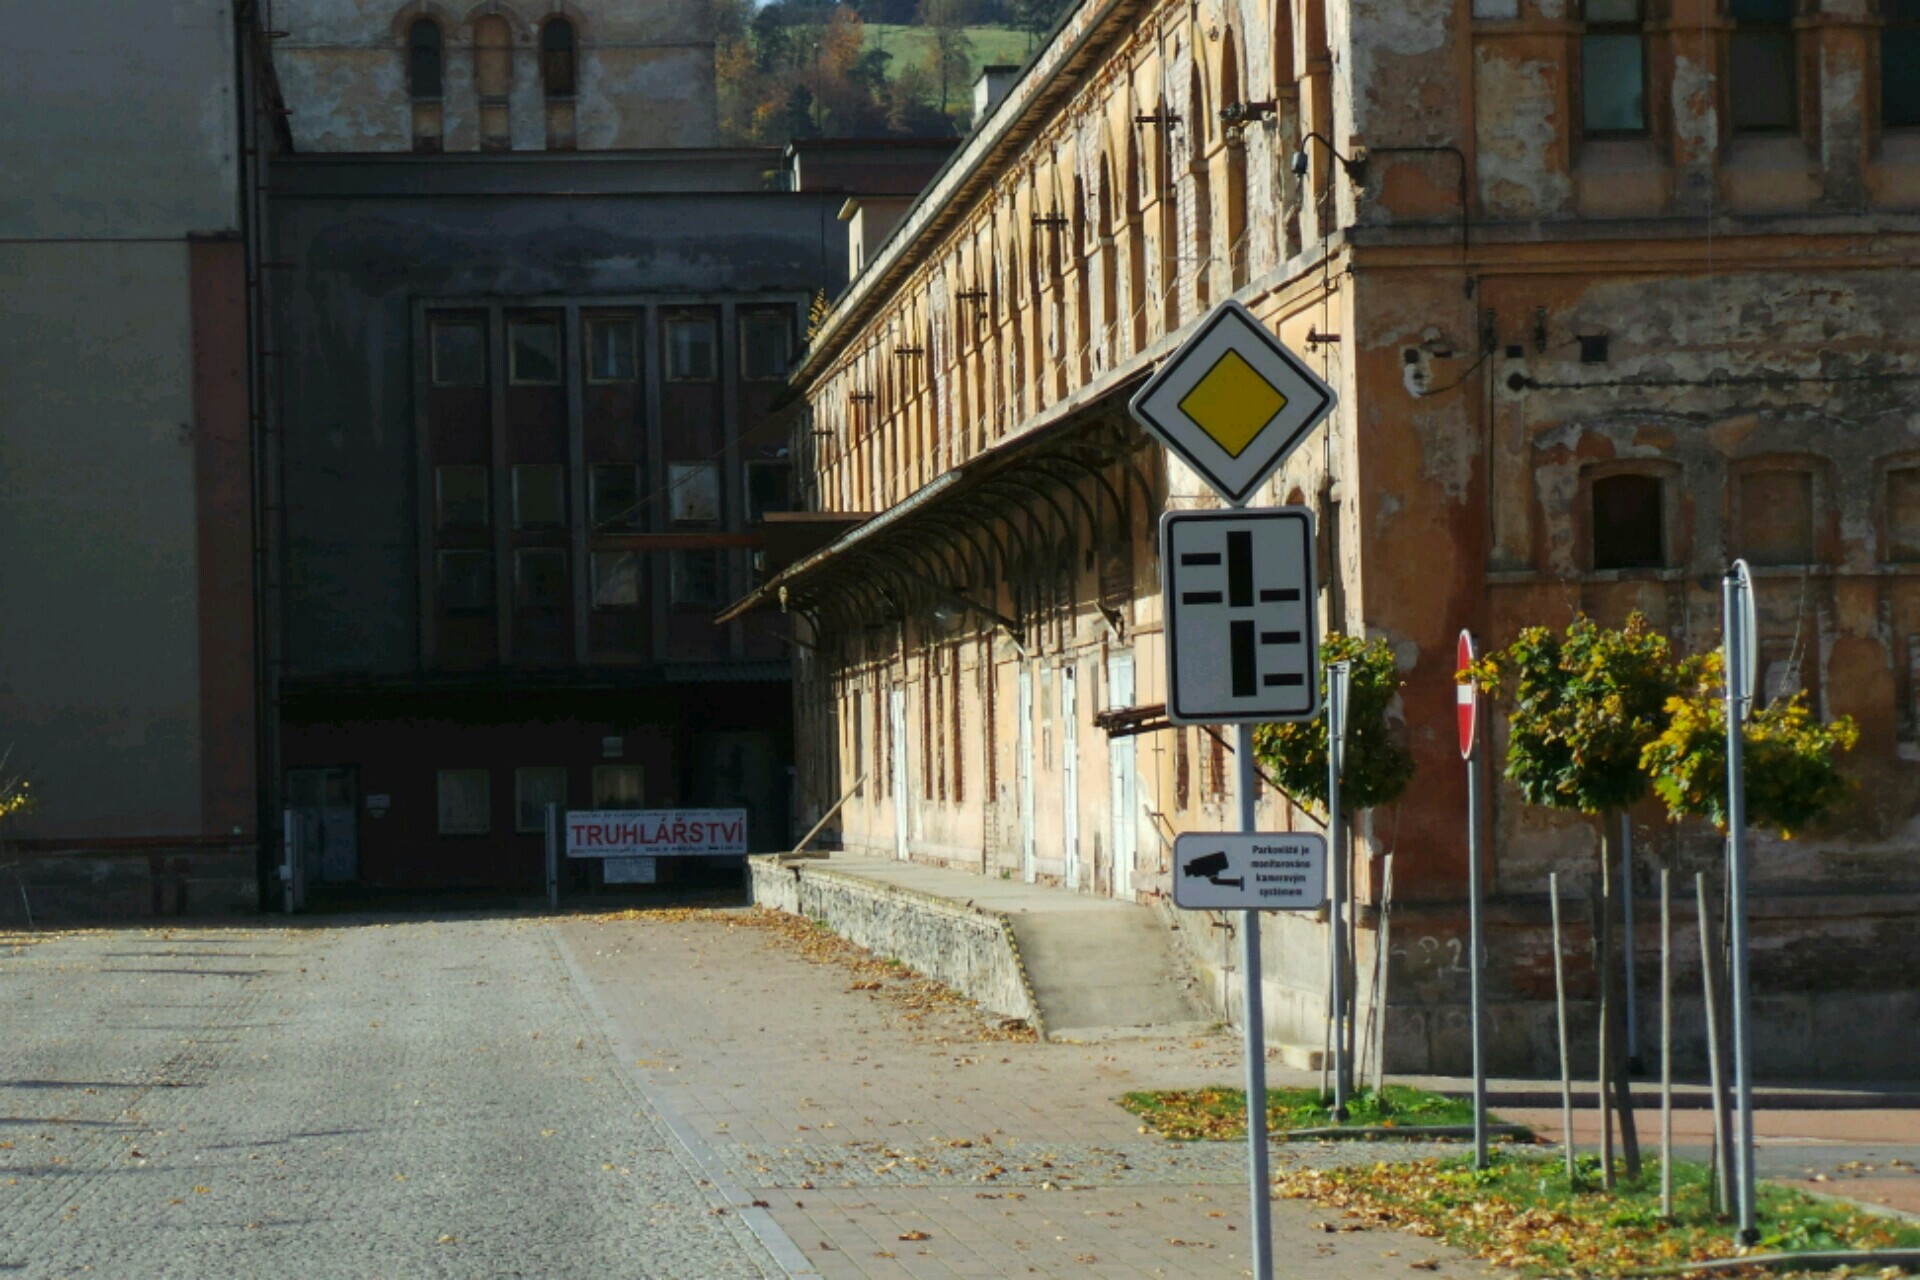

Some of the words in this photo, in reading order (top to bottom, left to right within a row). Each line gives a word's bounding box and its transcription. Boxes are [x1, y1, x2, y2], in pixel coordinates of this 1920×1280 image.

[571, 817, 744, 846] TRUHLÁŘSTVÍ
[1252, 845, 1298, 854] Parkoviště
[1301, 845, 1310, 856] je
[1255, 873, 1306, 884] kamerovým
[1259, 888, 1302, 898] systémem
